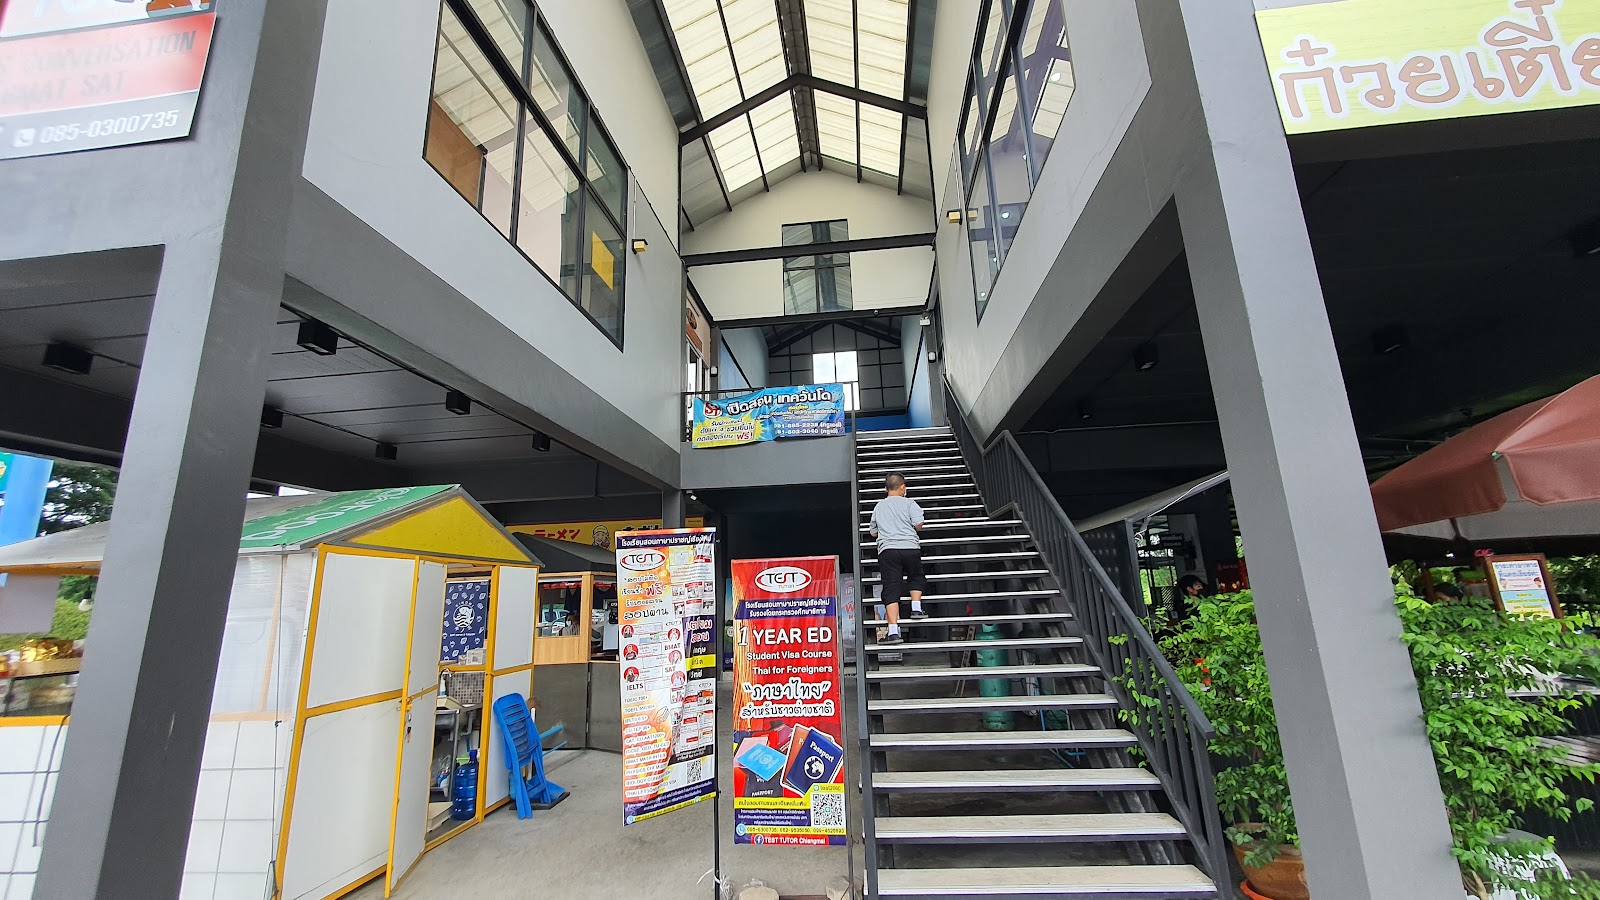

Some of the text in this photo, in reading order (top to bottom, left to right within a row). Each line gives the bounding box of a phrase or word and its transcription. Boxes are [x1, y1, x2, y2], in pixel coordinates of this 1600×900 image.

[80, 71, 128, 98] SAT
[39, 109, 180, 144] 085-0300735
[727, 395, 773, 416] เปิดสอน
[777, 388, 832, 404] เทควันโด
[736, 431, 753, 440] ฟรี!
[628, 553, 657, 564] TEST
[766, 572, 799, 584] TEST
[624, 606, 669, 620] สอบผ่าน
[738, 626, 832, 646] 1 YEAR ED
[747, 650, 833, 660] Student Visa Course
[752, 665, 833, 675] Thai for Foreigners
[626, 683, 644, 691] IELTS
[742, 702, 833, 717] สำหรับชาวต่างชาติ
[809, 741, 835, 763] Passport
[764, 836, 826, 845] TEST TUTOR Chiangmai
